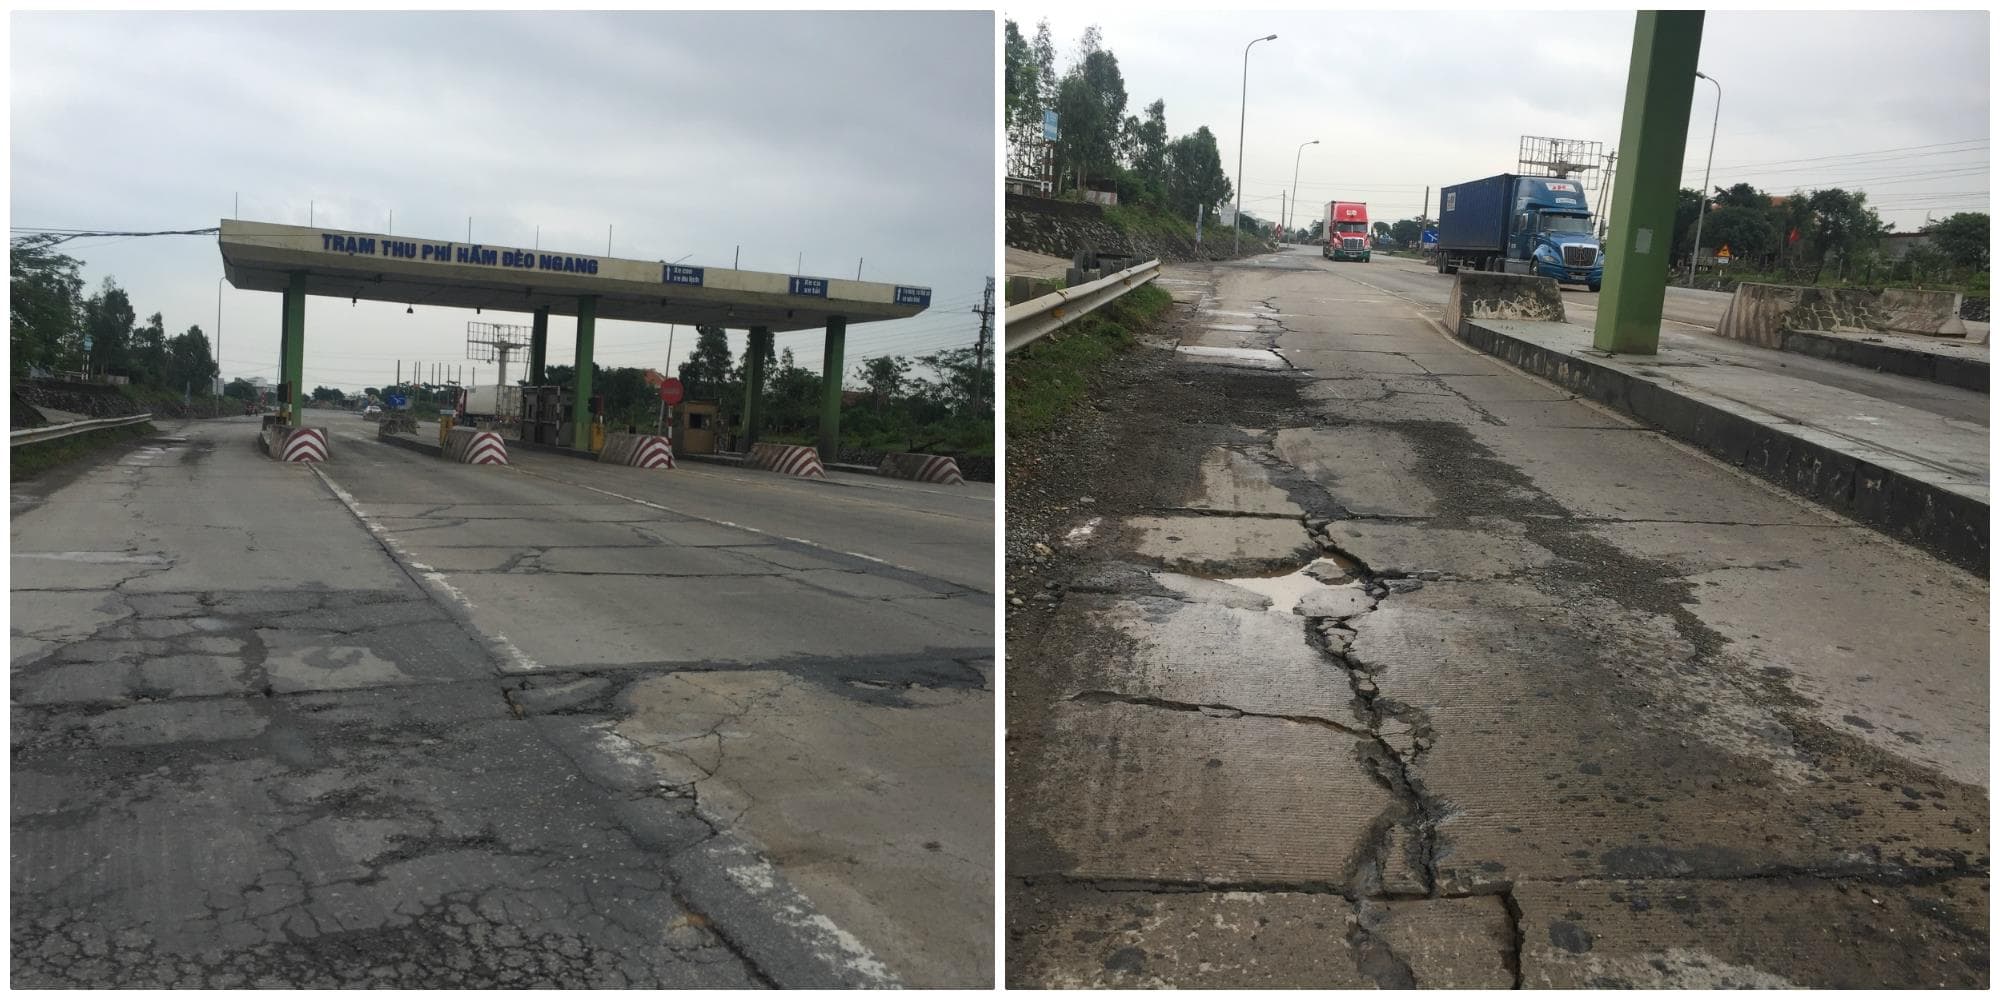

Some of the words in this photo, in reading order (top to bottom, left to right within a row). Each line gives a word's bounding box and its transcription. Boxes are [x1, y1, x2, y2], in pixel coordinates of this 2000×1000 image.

[321, 233, 376, 256] TRẠM
[381, 240, 417, 259] THU
[422, 242, 453, 262] PHÍ
[539, 254, 599, 275] NGANG
